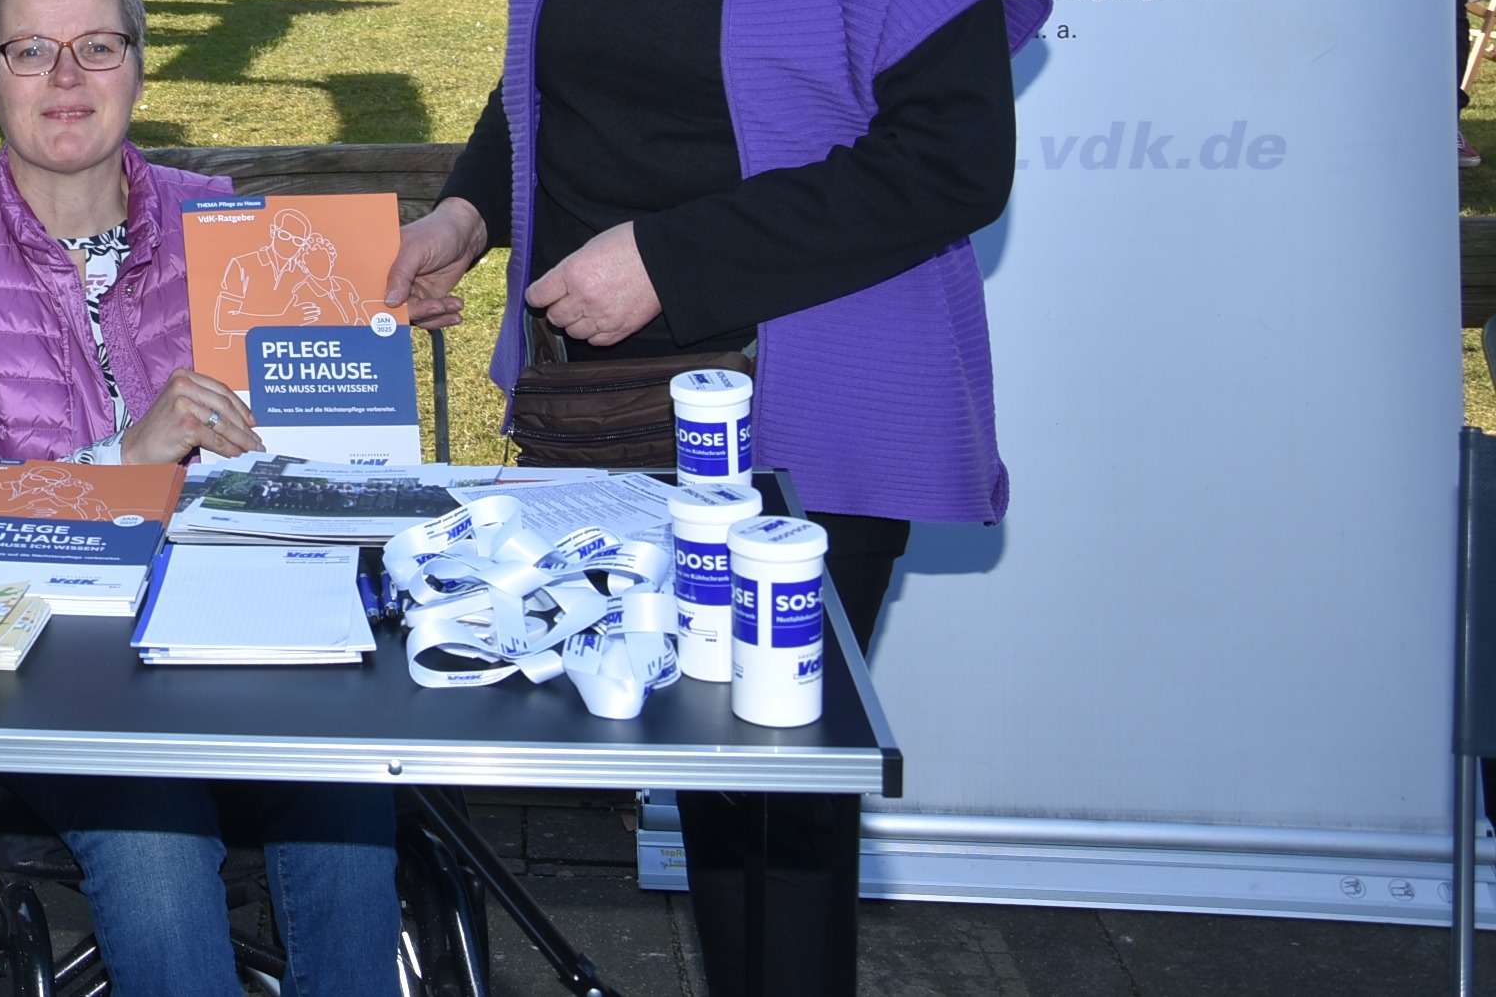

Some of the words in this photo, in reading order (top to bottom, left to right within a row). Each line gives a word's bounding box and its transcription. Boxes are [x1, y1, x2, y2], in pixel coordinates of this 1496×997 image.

[1016, 119, 1288, 171] .vdk.de
[197, 214, 256, 224] VdK-Ratgeber
[261, 340, 342, 359] PFLEGE
[263, 362, 294, 381] ZU
[299, 362, 378, 380] HAUSE.
[264, 384, 287, 394] WAS
[288, 384, 316, 394] MUSS
[317, 384, 336, 393] ICH
[336, 383, 379, 393] WISSEN?
[267, 406, 283, 414] Alles,
[323, 405, 365, 414] Nächstenpflege
[676, 428, 725, 447] -DOSE
[11, 532, 107, 546] HAUSE.
[676, 549, 728, 571] DOSE
